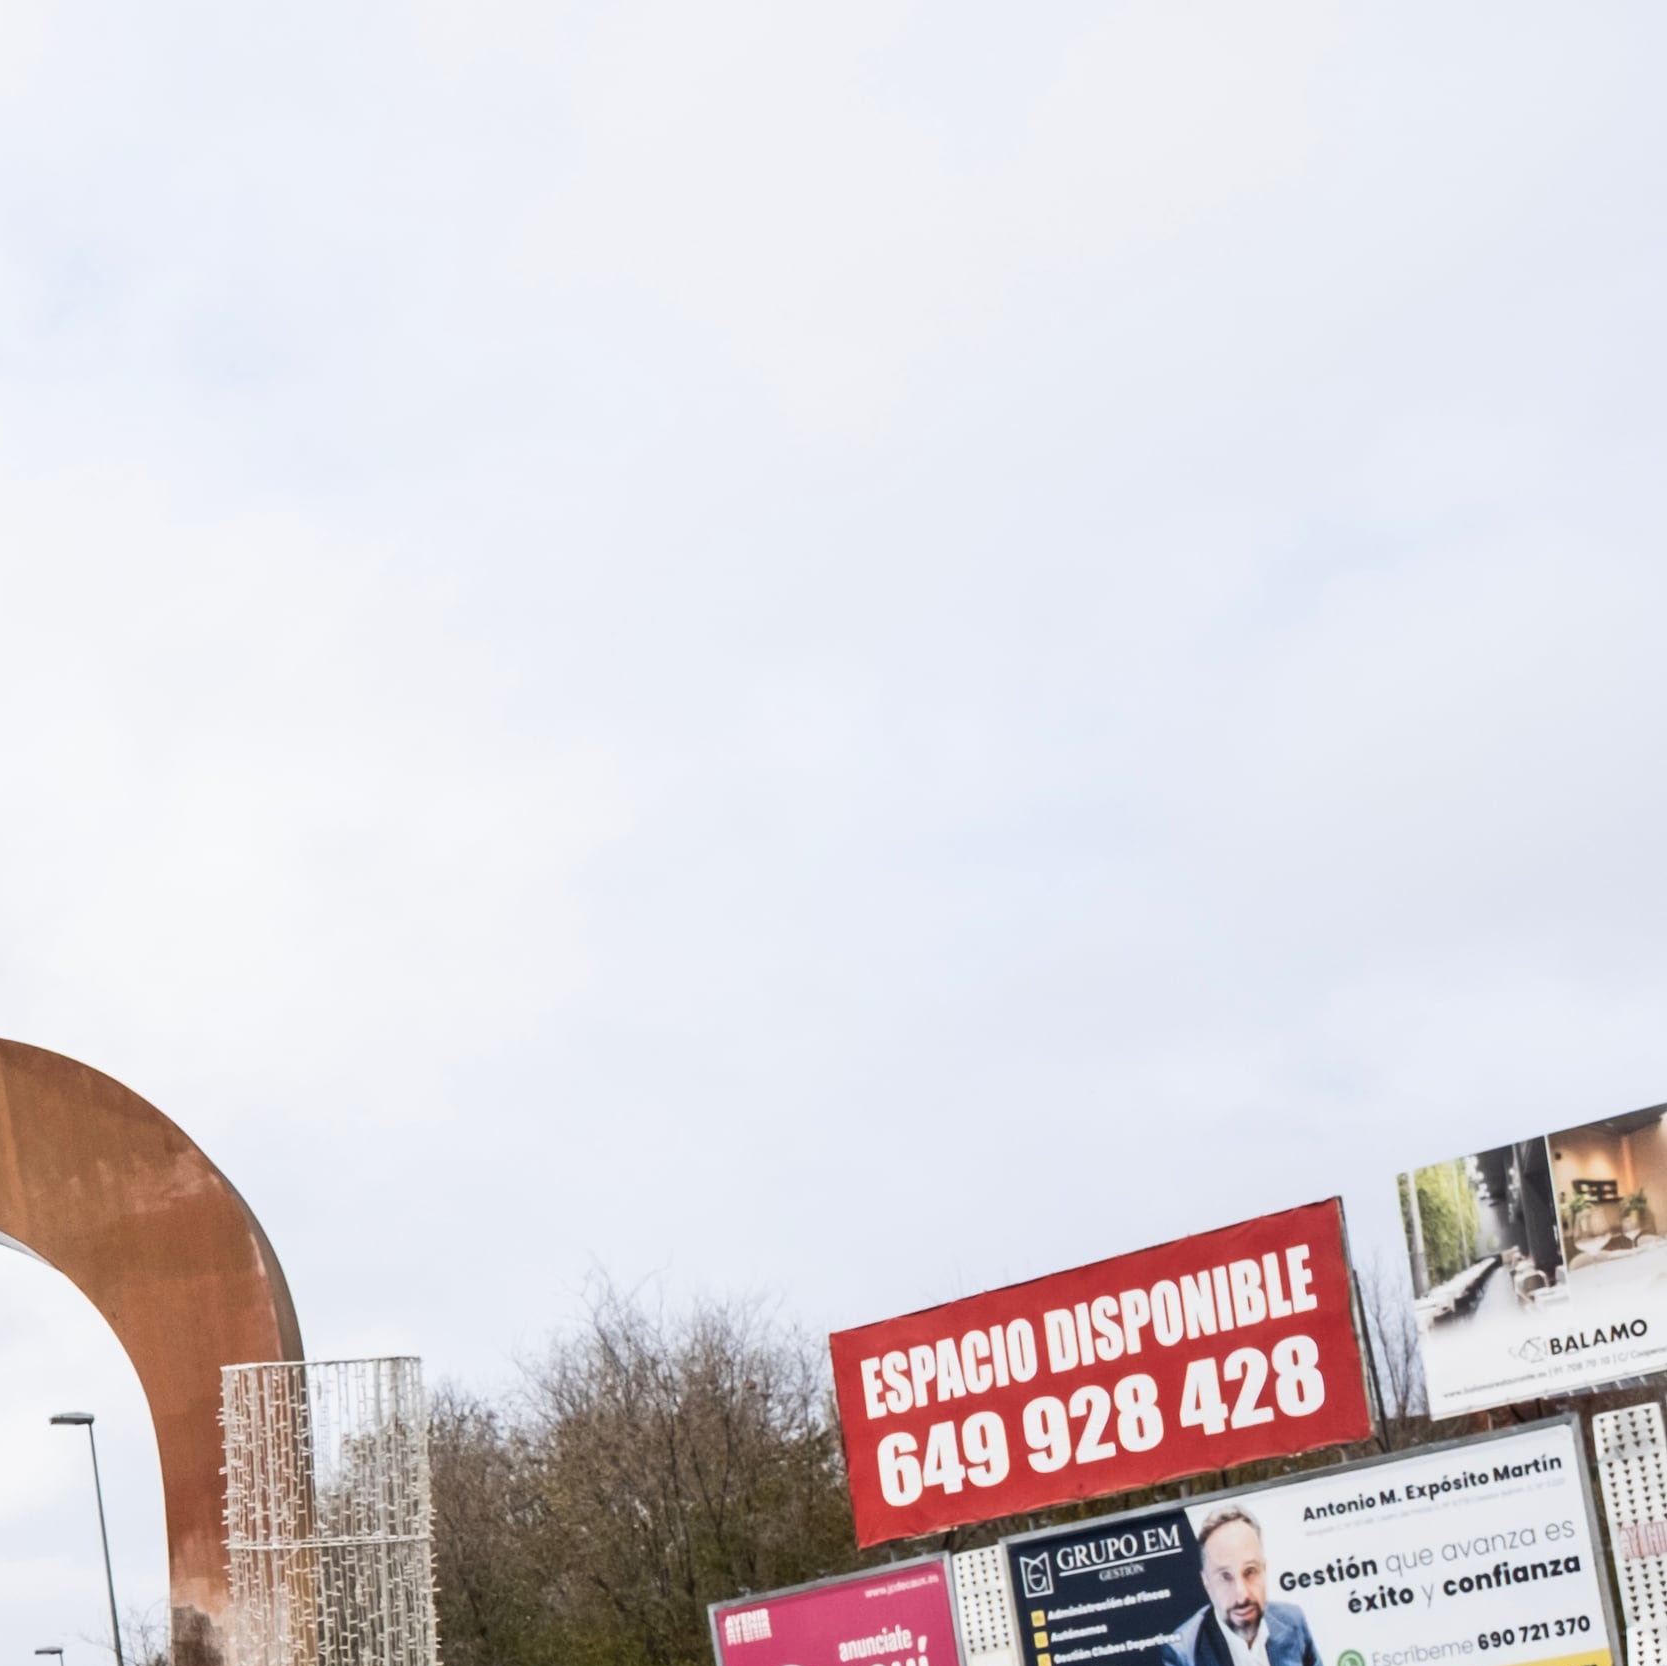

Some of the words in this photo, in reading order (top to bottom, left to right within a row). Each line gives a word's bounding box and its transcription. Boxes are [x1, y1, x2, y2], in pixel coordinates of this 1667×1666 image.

[860, 1317, 1038, 1420] ESPACIO
[1043, 1243, 1318, 1374] DISPONIBLE
[1549, 1318, 1648, 1356] BALAMO
[876, 1410, 1010, 1507] 649
[1021, 1372, 1165, 1475] 928
[1179, 1334, 1326, 1437] 428
[1303, 1492, 1377, 1522] Antonio
[1379, 1489, 1403, 1507] M.
[1406, 1470, 1489, 1501] Expósito
[1493, 1454, 1563, 1482] Martín
[1056, 1533, 1138, 1571] GRUPO
[1142, 1523, 1182, 1554] EM
[1279, 1555, 1378, 1592] Gestión
[1385, 1546, 1434, 1577] que
[1441, 1528, 1537, 1563] avanza
[1544, 1519, 1576, 1541] es
[1098, 1561, 1146, 1582] GESTIÓN
[1347, 1586, 1415, 1615] éxito
[1421, 1582, 1436, 1608] y
[1442, 1554, 1581, 1597] confianza
[1047, 1597, 1124, 1621] Administración
[1136, 1588, 1172, 1603] Fincas
[1053, 1648, 1092, 1664] Gestión
[1091, 1642, 1126, 1657] Clubes
[1477, 1632, 1516, 1651] 690
[1518, 1622, 1550, 1643] 721
[1553, 1614, 1591, 1637] 370
